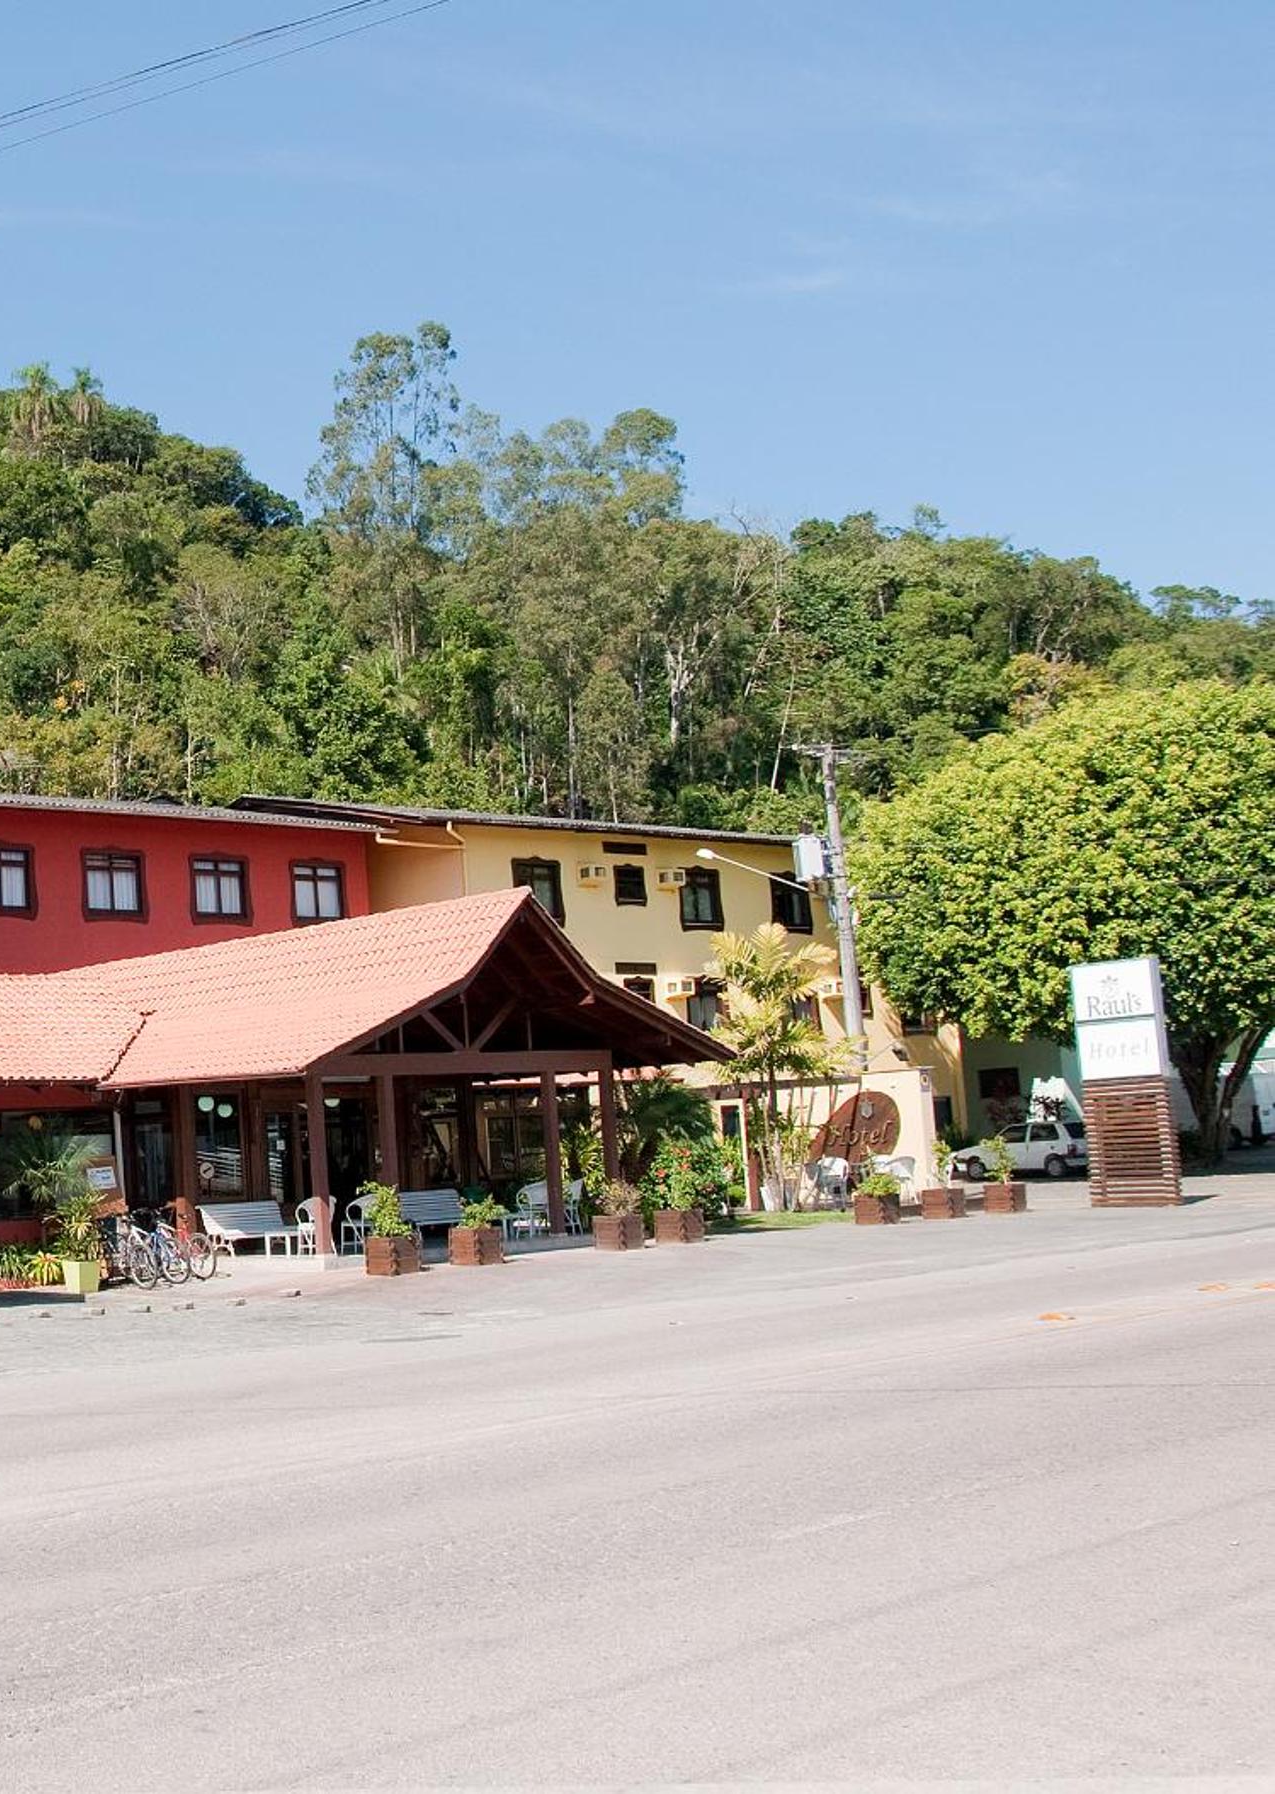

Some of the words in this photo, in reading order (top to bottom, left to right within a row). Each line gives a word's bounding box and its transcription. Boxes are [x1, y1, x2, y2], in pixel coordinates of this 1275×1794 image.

[1087, 991, 1142, 1018] Raul's
[1089, 1036, 1149, 1060] Hotel
[827, 1119, 895, 1147] Hotel
